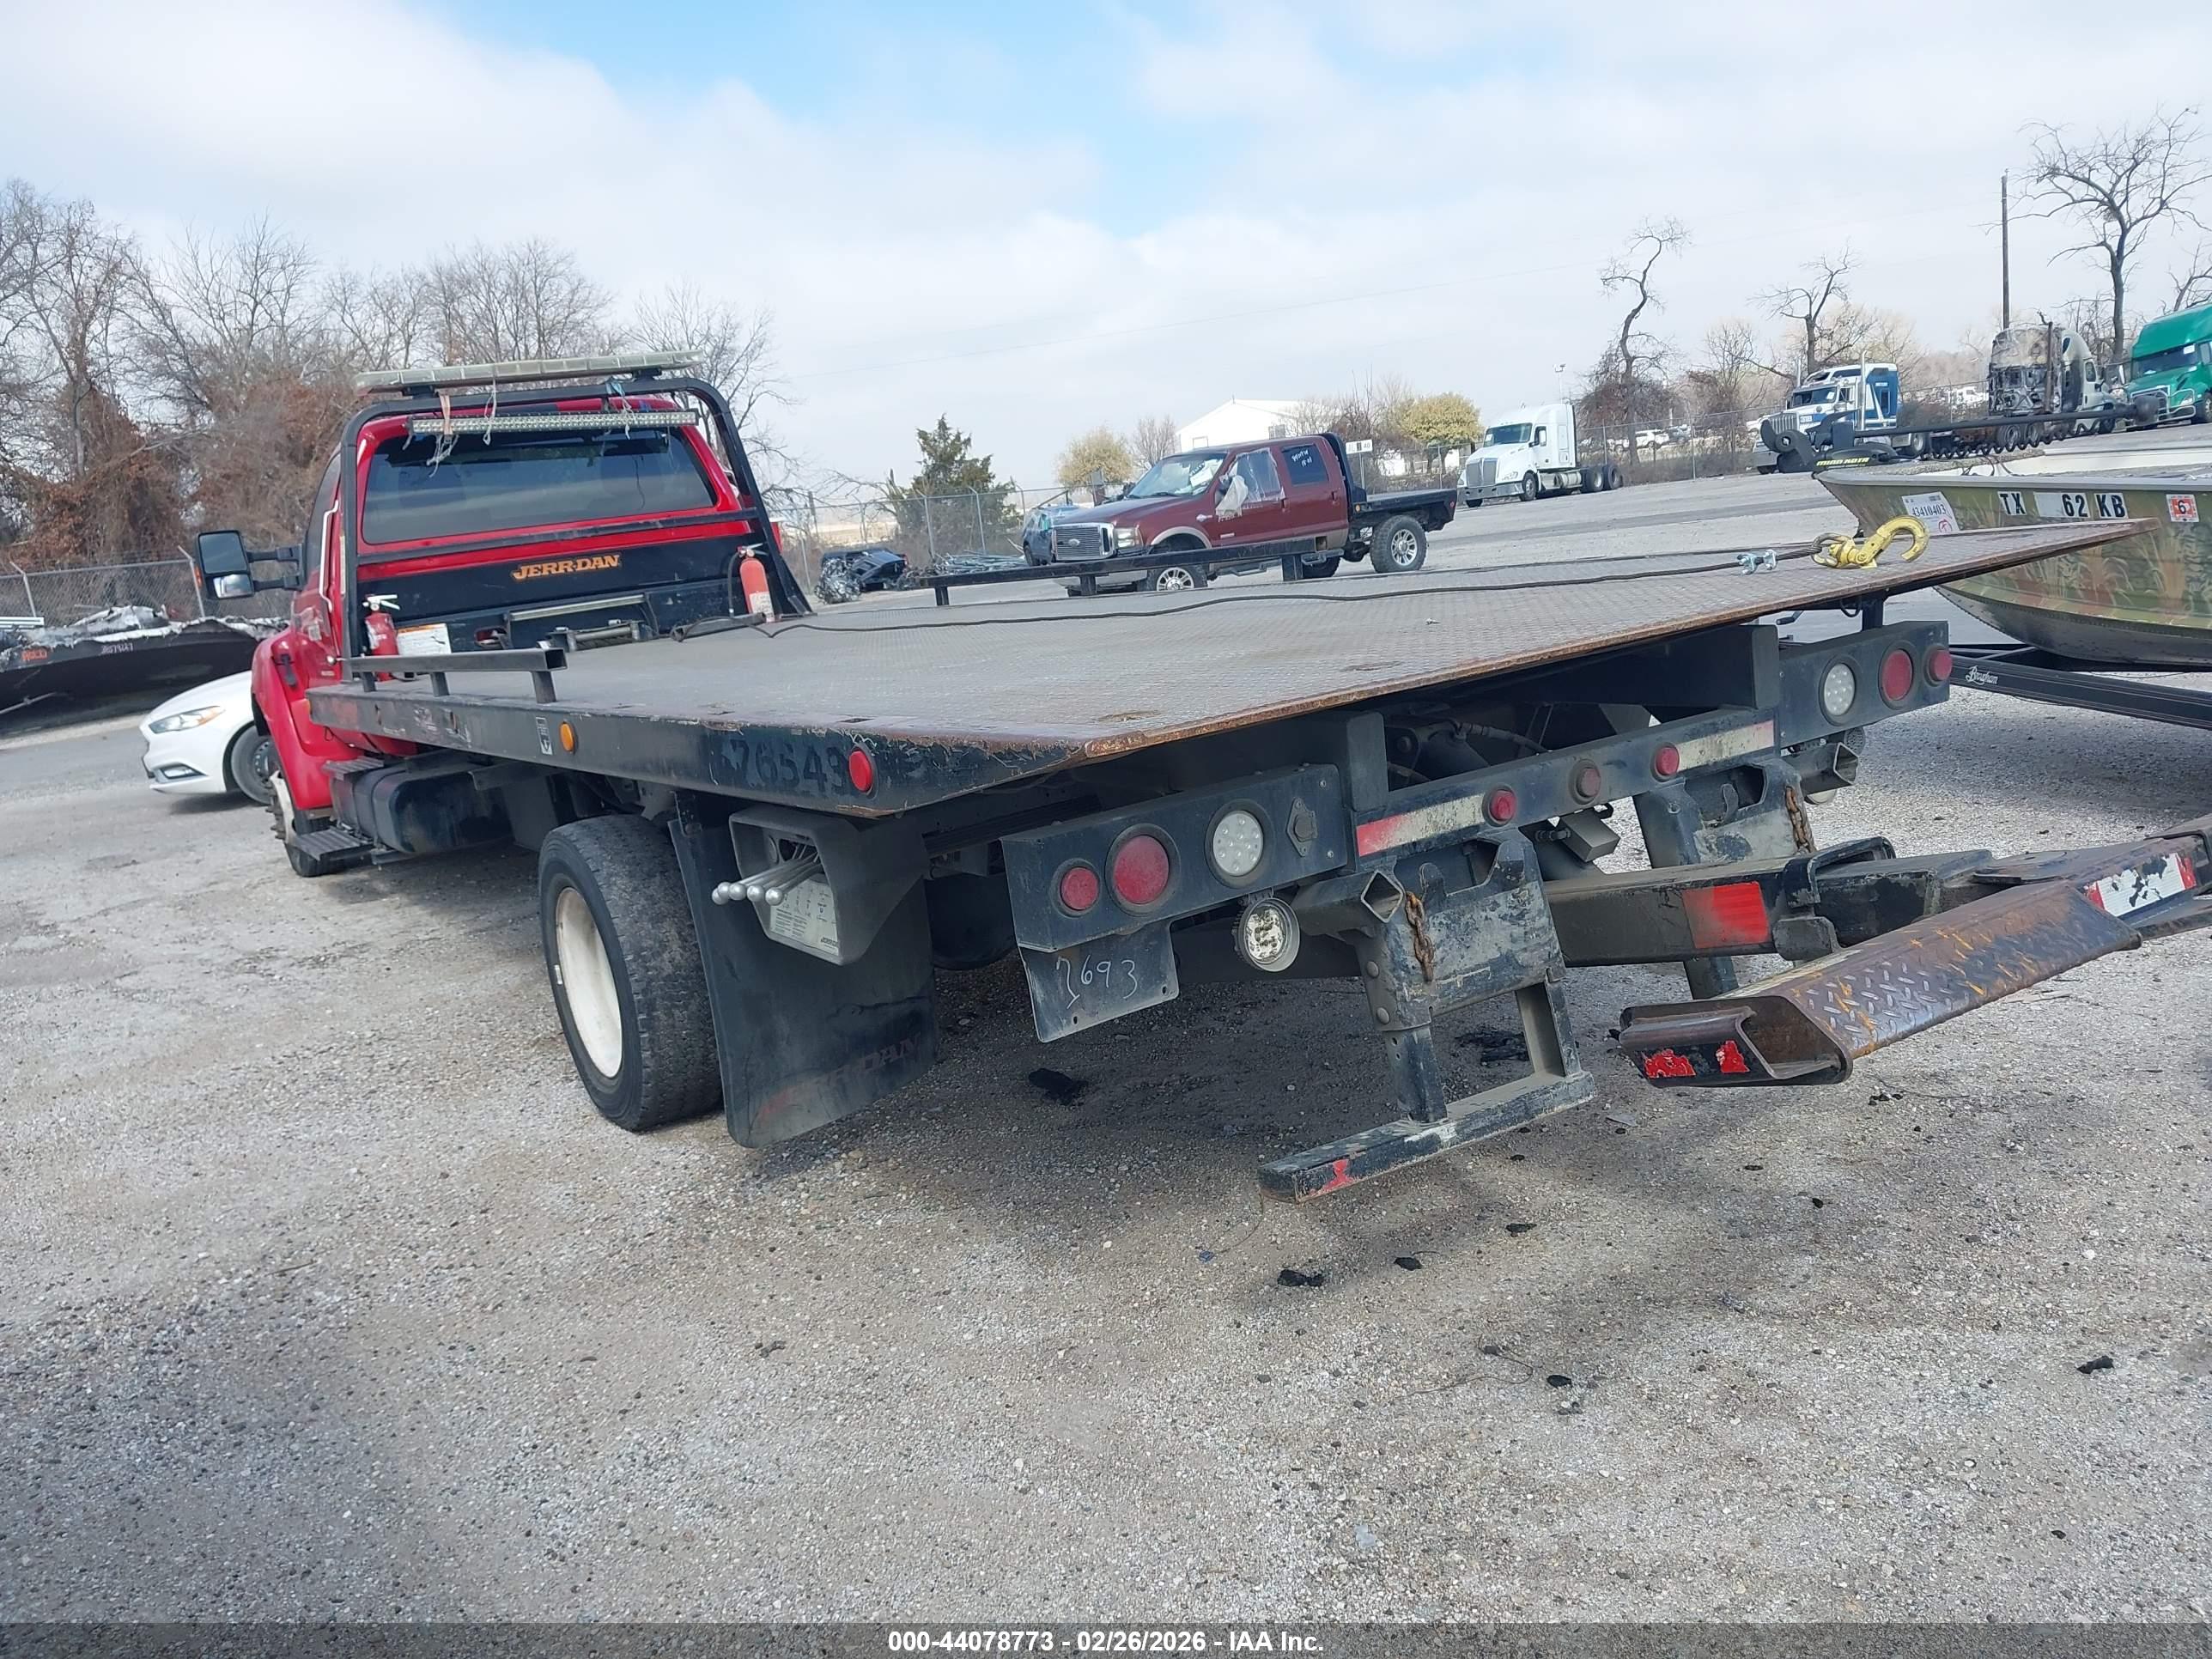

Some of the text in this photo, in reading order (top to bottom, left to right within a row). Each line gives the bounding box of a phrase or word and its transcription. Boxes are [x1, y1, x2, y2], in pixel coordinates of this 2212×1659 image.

[2000, 493, 2125, 518] TX 62 KB
[513, 554, 620, 580] JERR-DAN
